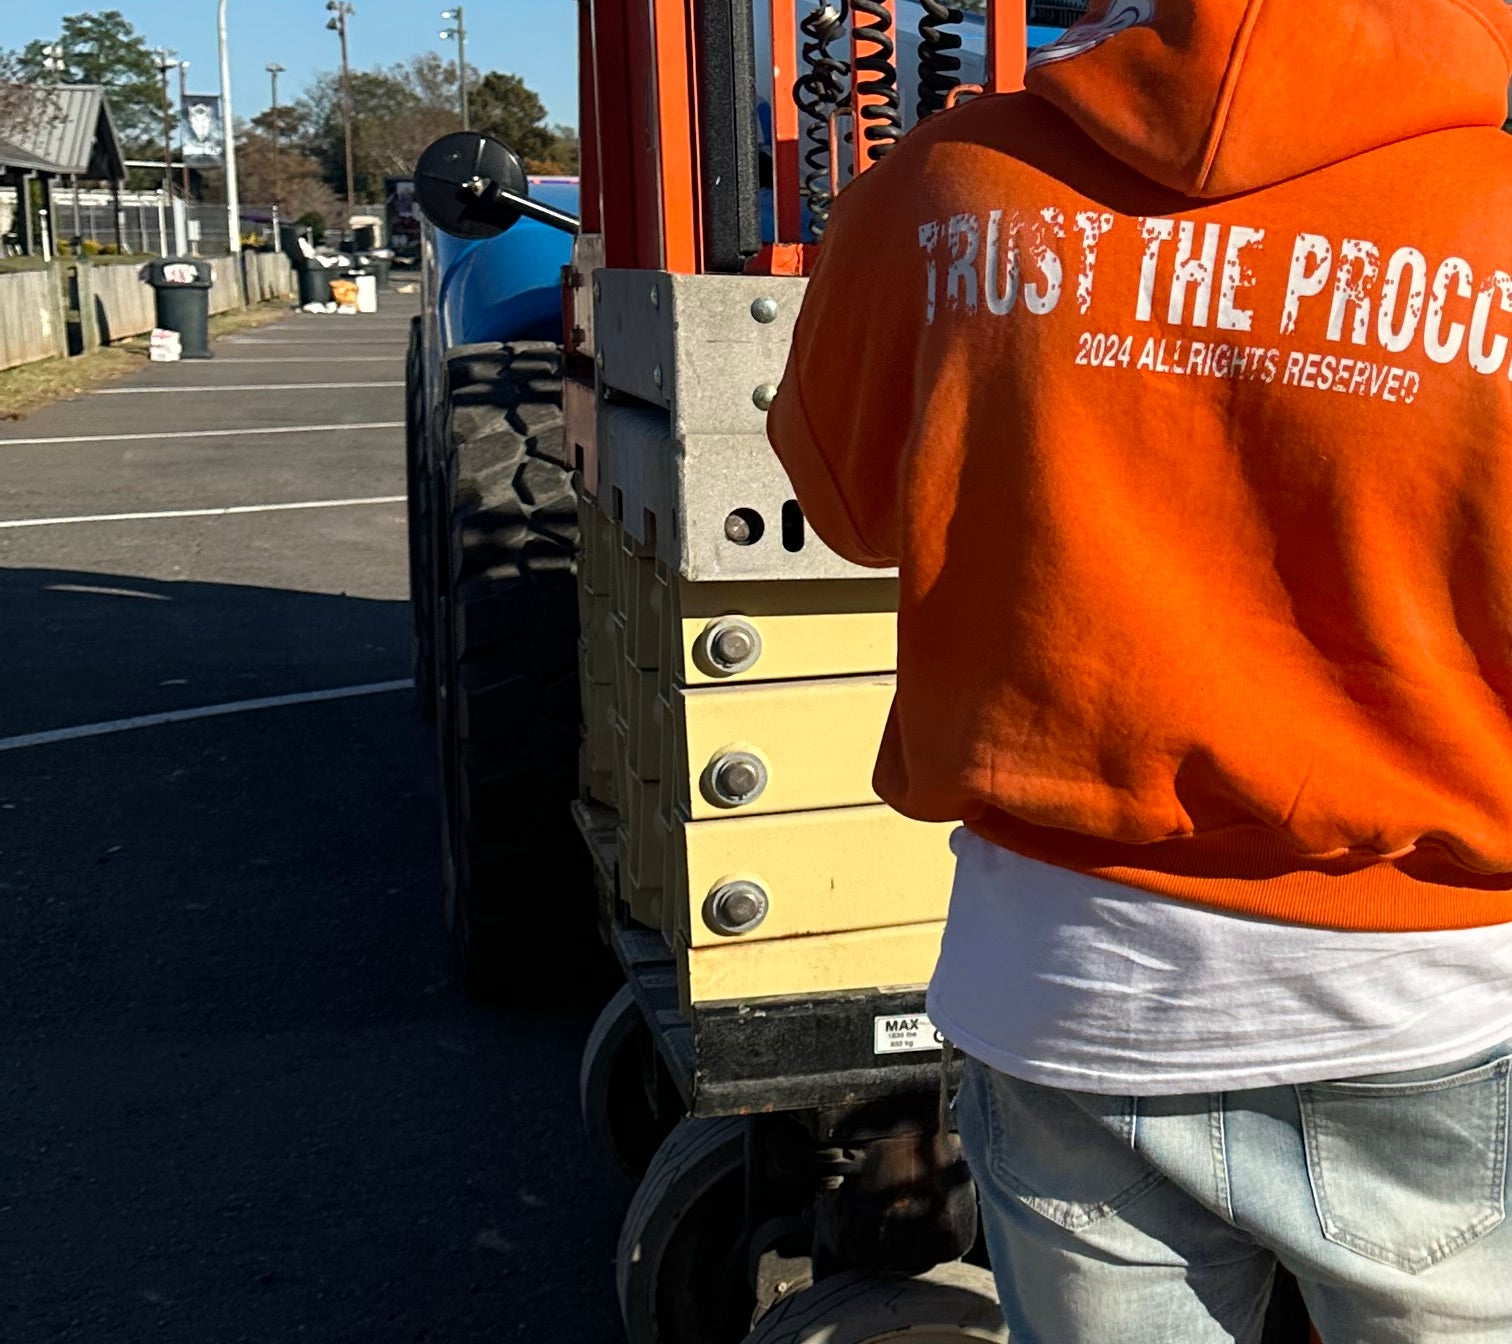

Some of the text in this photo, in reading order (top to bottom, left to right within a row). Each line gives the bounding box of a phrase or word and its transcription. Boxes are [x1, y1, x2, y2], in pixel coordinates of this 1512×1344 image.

[918, 207, 1113, 326] TRUST
[1136, 216, 1265, 332] THE
[1074, 331, 1134, 369] 2024
[1282, 351, 1421, 405] RESERVED
[885, 1018, 919, 1032] MAX
